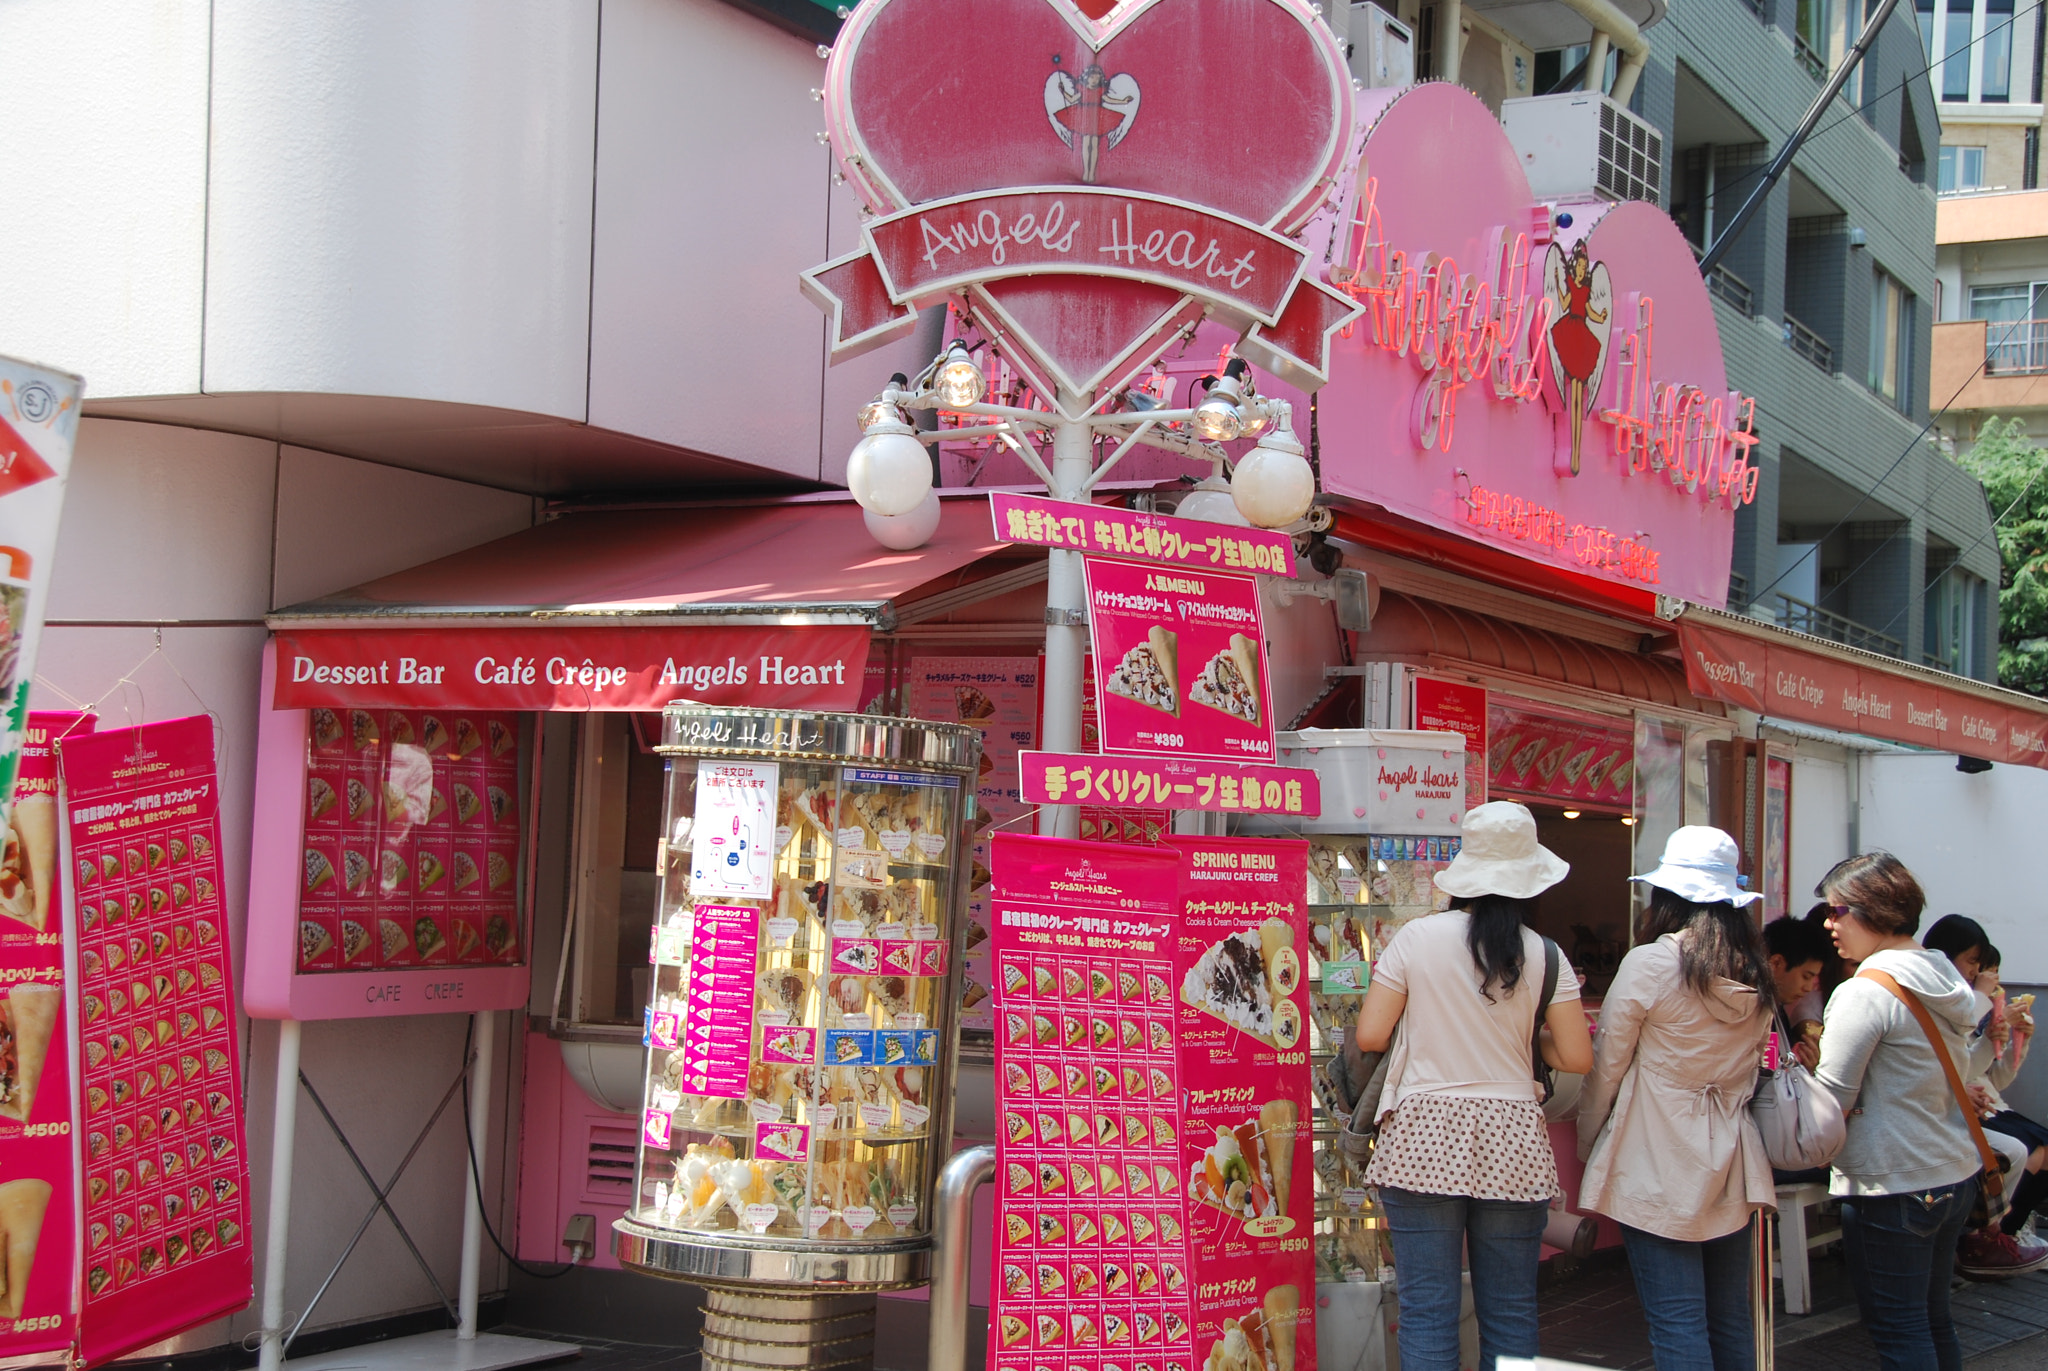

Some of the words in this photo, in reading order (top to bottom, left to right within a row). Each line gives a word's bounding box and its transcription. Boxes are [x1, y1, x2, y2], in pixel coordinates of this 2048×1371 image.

[919, 200, 1081, 271] Angels
[1098, 203, 1256, 290] Heart
[1336, 158, 1554, 453] Angels
[1601, 291, 1760, 507] Heart
[1006, 507, 1087, 548] 焼きたて!
[1093, 519, 1288, 574] 牛乳と卵クレープ生地の店
[1573, 523, 1616, 571] CAFE
[1095, 589, 1172, 613] バナナチョコ生クリーム
[292, 656, 389, 685] Dessert
[397, 657, 446, 685] Bar
[474, 656, 537, 685] Café
[546, 657, 628, 692] Crêpe
[658, 656, 749, 692] Angels
[758, 656, 846, 685] Heart
[1696, 651, 1738, 685] Dessert
[1738, 660, 1756, 690] Bar
[1014, 674, 1036, 685] ¥520
[1776, 670, 1797, 699] Café
[1799, 676, 1825, 709] Crêpe
[1842, 688, 1868, 720] Angels
[1869, 693, 1892, 721] Heart
[1907, 701, 1934, 729] Dessert
[1935, 708, 1949, 733] Bar
[1010, 731, 1031, 741] ¥560
[1961, 715, 1977, 738] Café
[1978, 719, 1997, 743] Crêpe
[1154, 732, 1184, 748] ¥390
[1241, 739, 1269, 754] ¥440
[860, 771, 886, 780] STAFF
[1377, 764, 1418, 793] Angels
[1420, 765, 1459, 789] Heart
[1045, 765, 1303, 812] 手づくりクレープ生地の店
[1415, 790, 1451, 799] HARAJUKU
[1192, 851, 1238, 869] SPRING
[1240, 853, 1276, 870] MENU
[1190, 870, 1232, 882] HARAJUKU
[1233, 872, 1254, 882] CAFE
[1254, 873, 1278, 883] CREPE
[1186, 901, 1249, 916] クッキー&クリーム
[1251, 902, 1295, 916] チーズケーキ
[1112, 919, 1171, 938] カフェクレープ
[1185, 916, 1206, 927] Cookie
[1207, 917, 1213, 926] &
[1213, 917, 1232, 927] Cream
[366, 985, 401, 1003] CAFE
[425, 982, 464, 1001] CREPE
[1209, 1049, 1233, 1058] 生クリーム
[1277, 1052, 1306, 1066] ¥490
[1191, 1088, 1220, 1104] フルーツ
[1191, 1106, 1210, 1115] Mixed
[1210, 1104, 1223, 1114] Fruit
[1223, 1103, 1246, 1114] Pudding
[1246, 1103, 1264, 1112] Crepe
[23, 1121, 71, 1138] ¥500
[1279, 1237, 1309, 1252] ¥590
[1199, 1282, 1221, 1299] バナナ
[1200, 1301, 1220, 1311] Banana
[1219, 1297, 1241, 1308] Pudding
[1241, 1295, 1258, 1305] Crepe
[13, 1315, 62, 1333] ¥550
